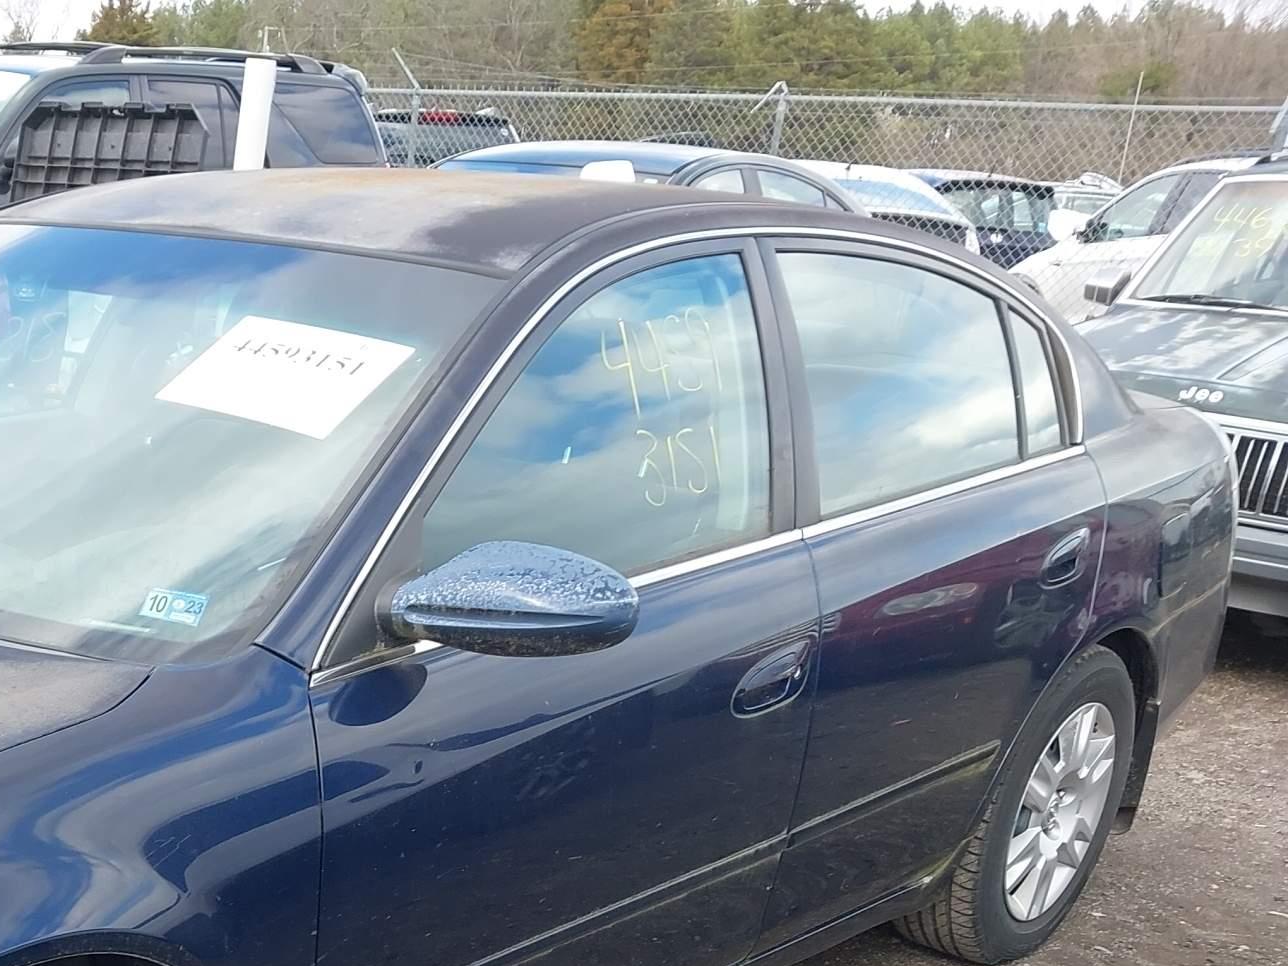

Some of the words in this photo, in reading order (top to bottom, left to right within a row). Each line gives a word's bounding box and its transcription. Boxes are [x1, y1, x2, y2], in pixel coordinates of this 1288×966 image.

[231, 338, 366, 377] 44593151
[636, 425, 721, 507] 3151
[149, 594, 169, 613] 10
[184, 600, 205, 615] 23
